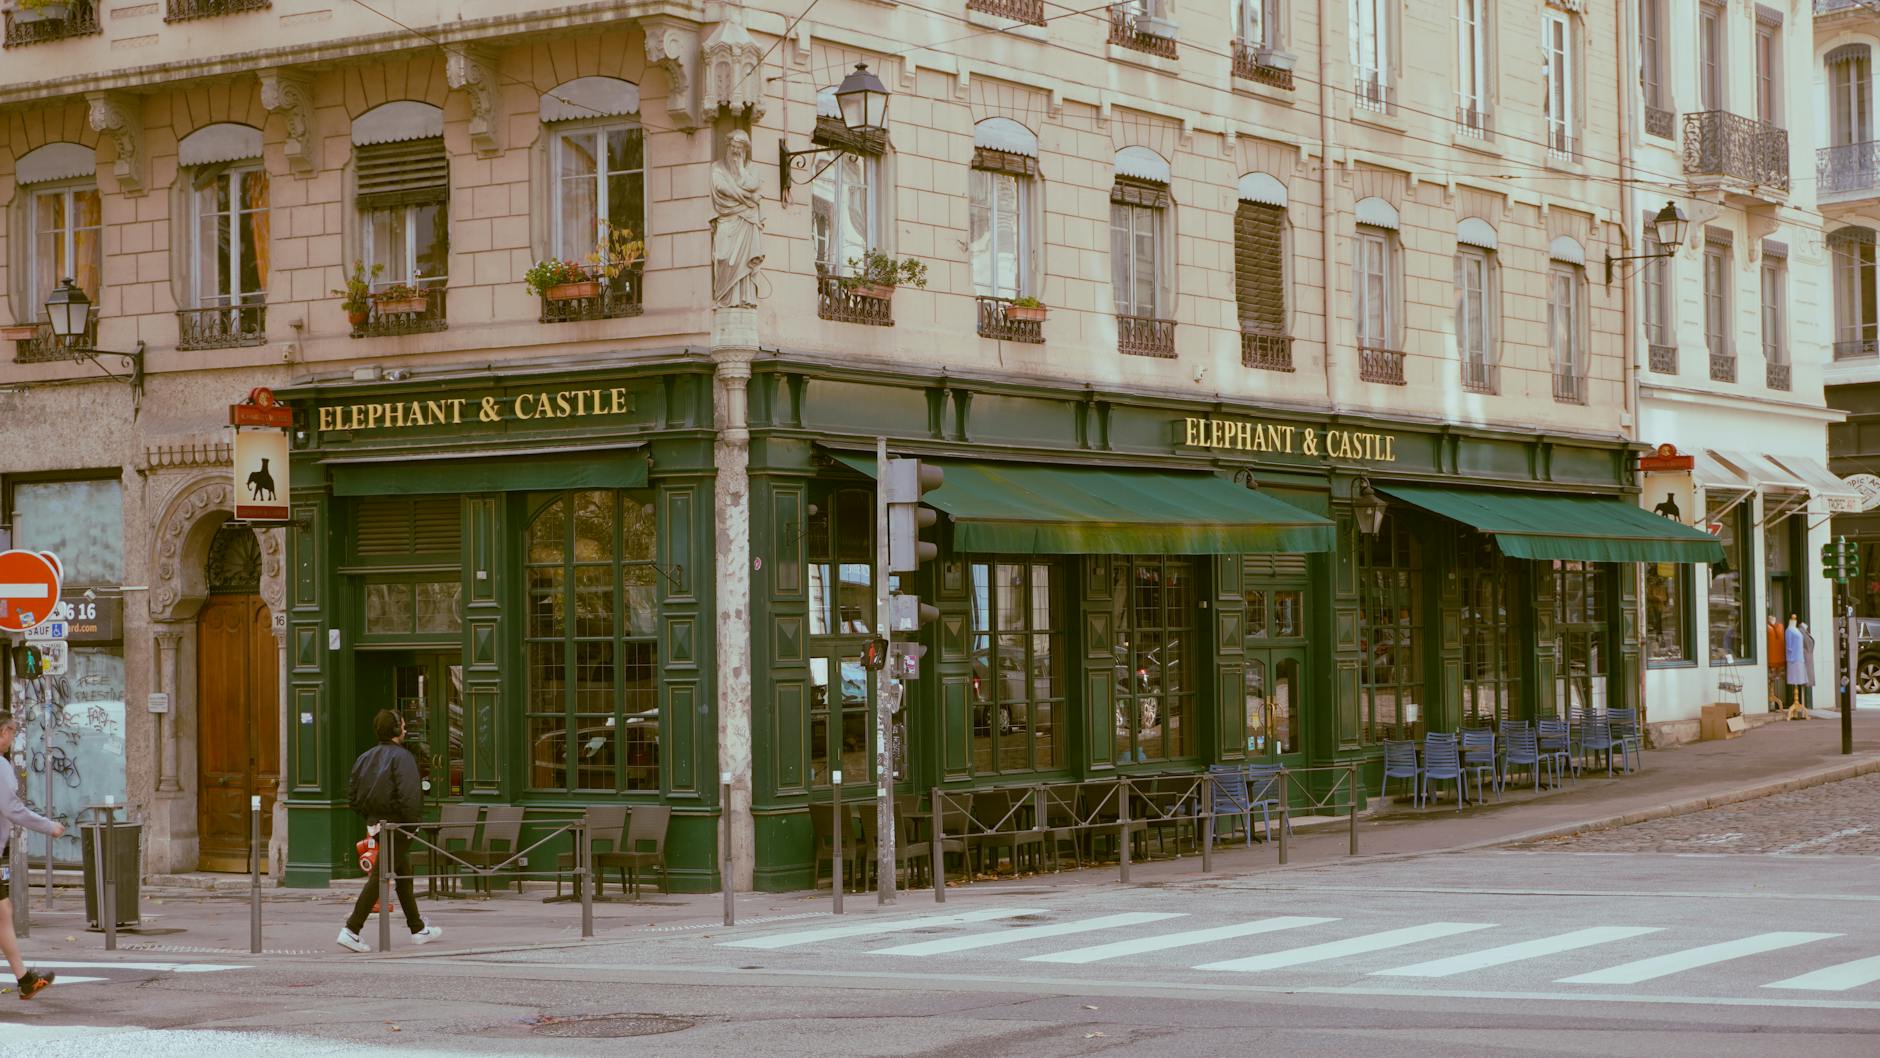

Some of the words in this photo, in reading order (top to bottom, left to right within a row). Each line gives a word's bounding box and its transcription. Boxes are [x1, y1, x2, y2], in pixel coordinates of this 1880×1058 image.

[318, 398, 466, 431] ELEPHANT
[478, 396, 501, 422] &
[514, 387, 627, 419] CASTLE
[1184, 417, 1295, 454] ELEPHANT
[1303, 427, 1319, 456] &
[1326, 430, 1396, 462] CASTLE
[78, 603, 97, 620] 16
[274, 615, 285, 626] 16
[28, 626, 49, 636] SAUF
